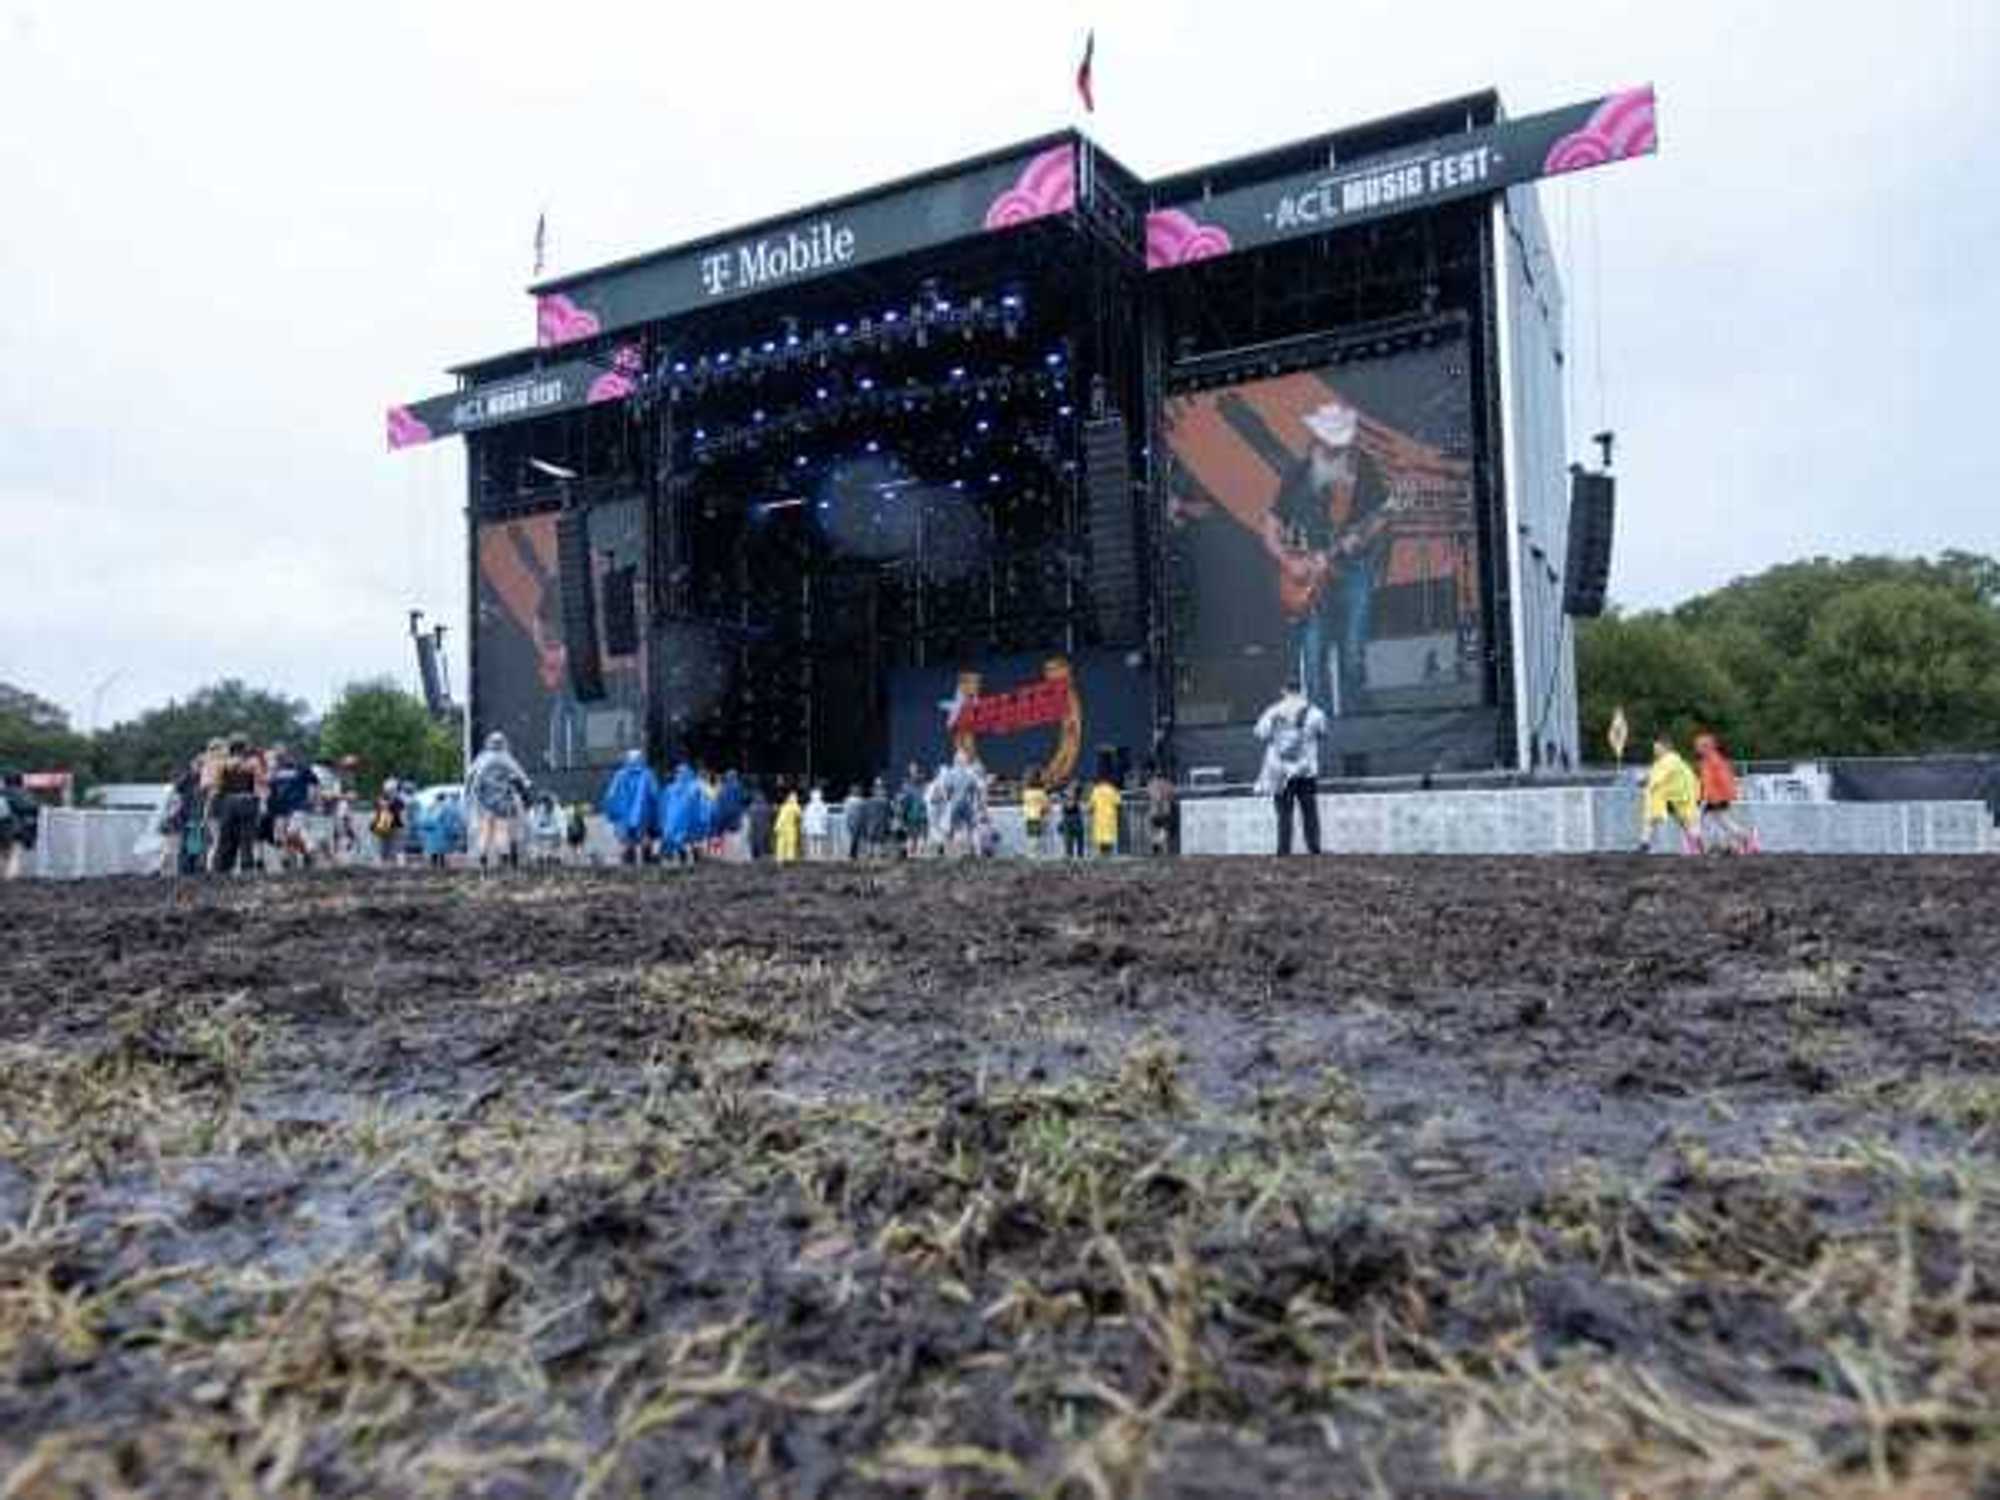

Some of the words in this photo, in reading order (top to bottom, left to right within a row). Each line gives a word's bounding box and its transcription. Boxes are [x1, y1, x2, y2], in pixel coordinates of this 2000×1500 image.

[1277, 184, 1339, 230] ACL
[1430, 147, 1488, 191] FEST
[739, 221, 855, 288] Mobile
